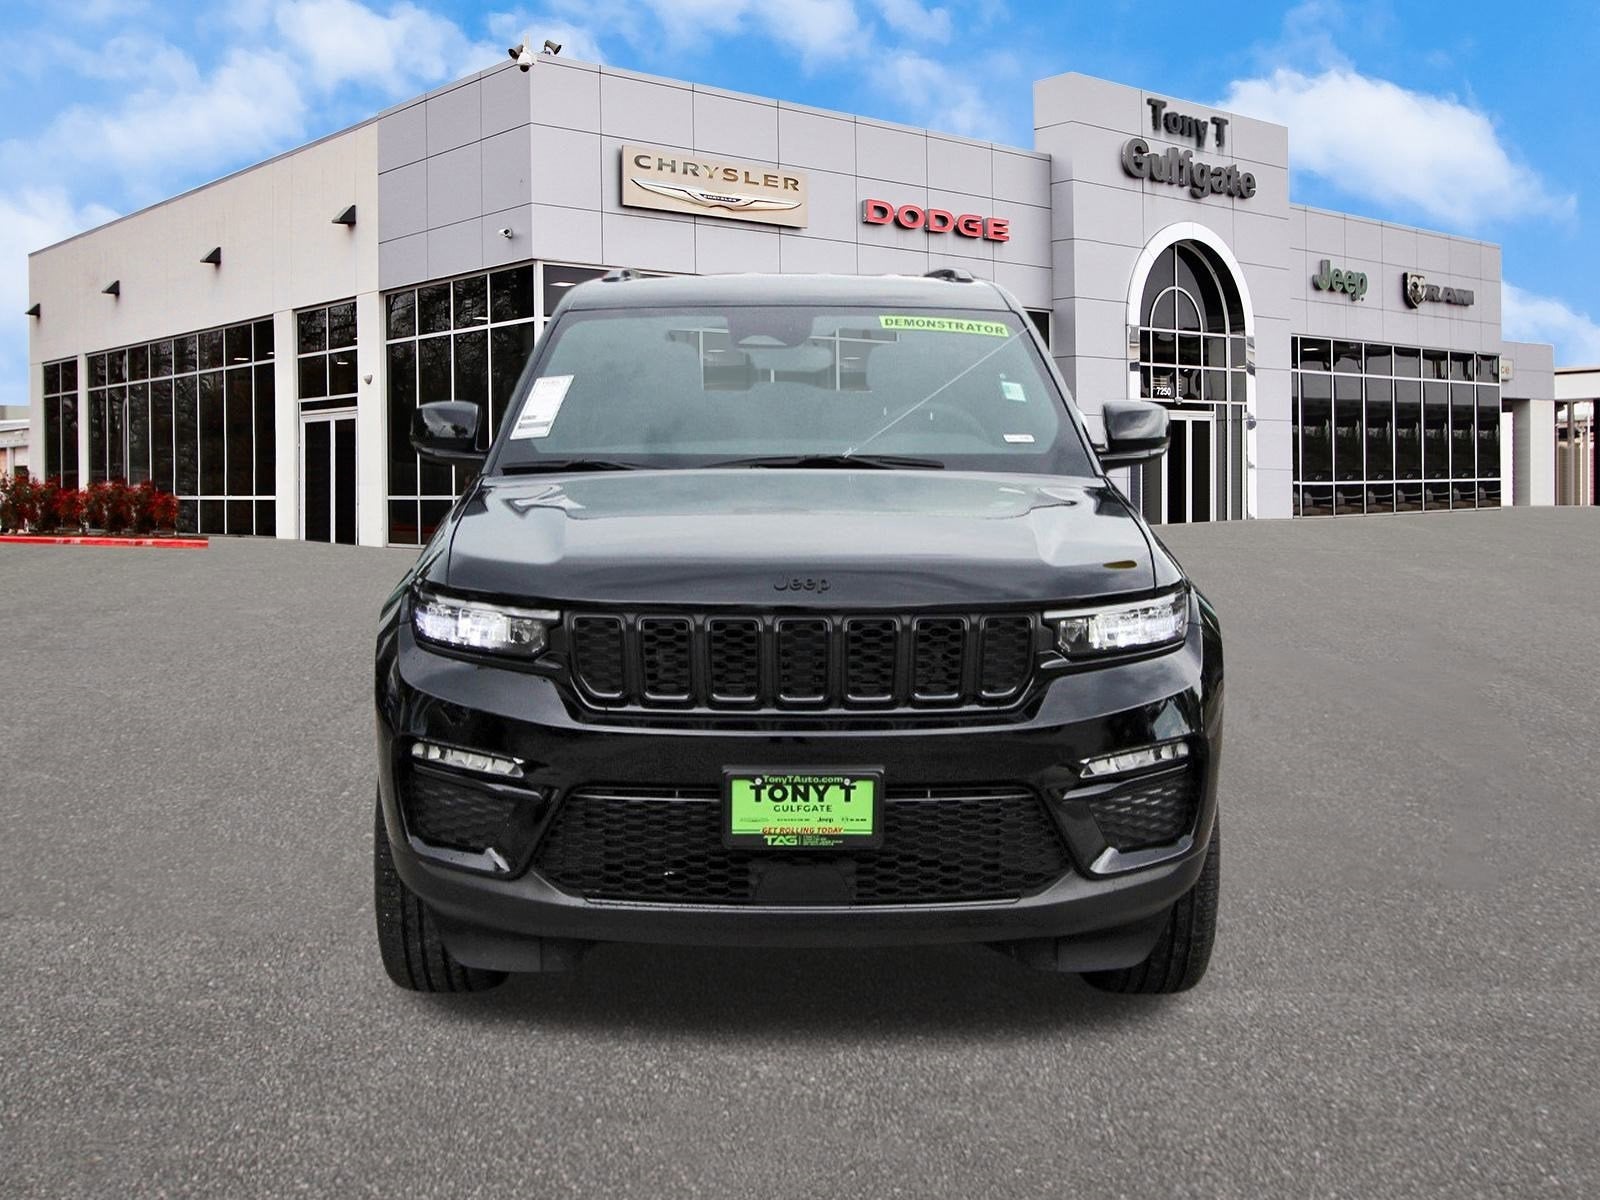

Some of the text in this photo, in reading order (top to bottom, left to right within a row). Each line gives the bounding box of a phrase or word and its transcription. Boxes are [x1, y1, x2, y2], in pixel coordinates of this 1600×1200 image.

[1146, 98, 1229, 148] Tony T
[633, 154, 801, 192] CHRYSLER
[1121, 137, 1257, 199] Gulfgate
[863, 198, 1010, 242] DODGE
[1313, 259, 1368, 301] Jeep
[1424, 284, 1475, 306] RAM
[884, 318, 1005, 335] DEMONSTRATOR
[1156, 387, 1172, 396] 7250
[773, 576, 832, 594] Jeep
[763, 775, 844, 784] TonyTAuto.com
[750, 784, 857, 802] TONY T
[764, 835, 798, 846] TAG
